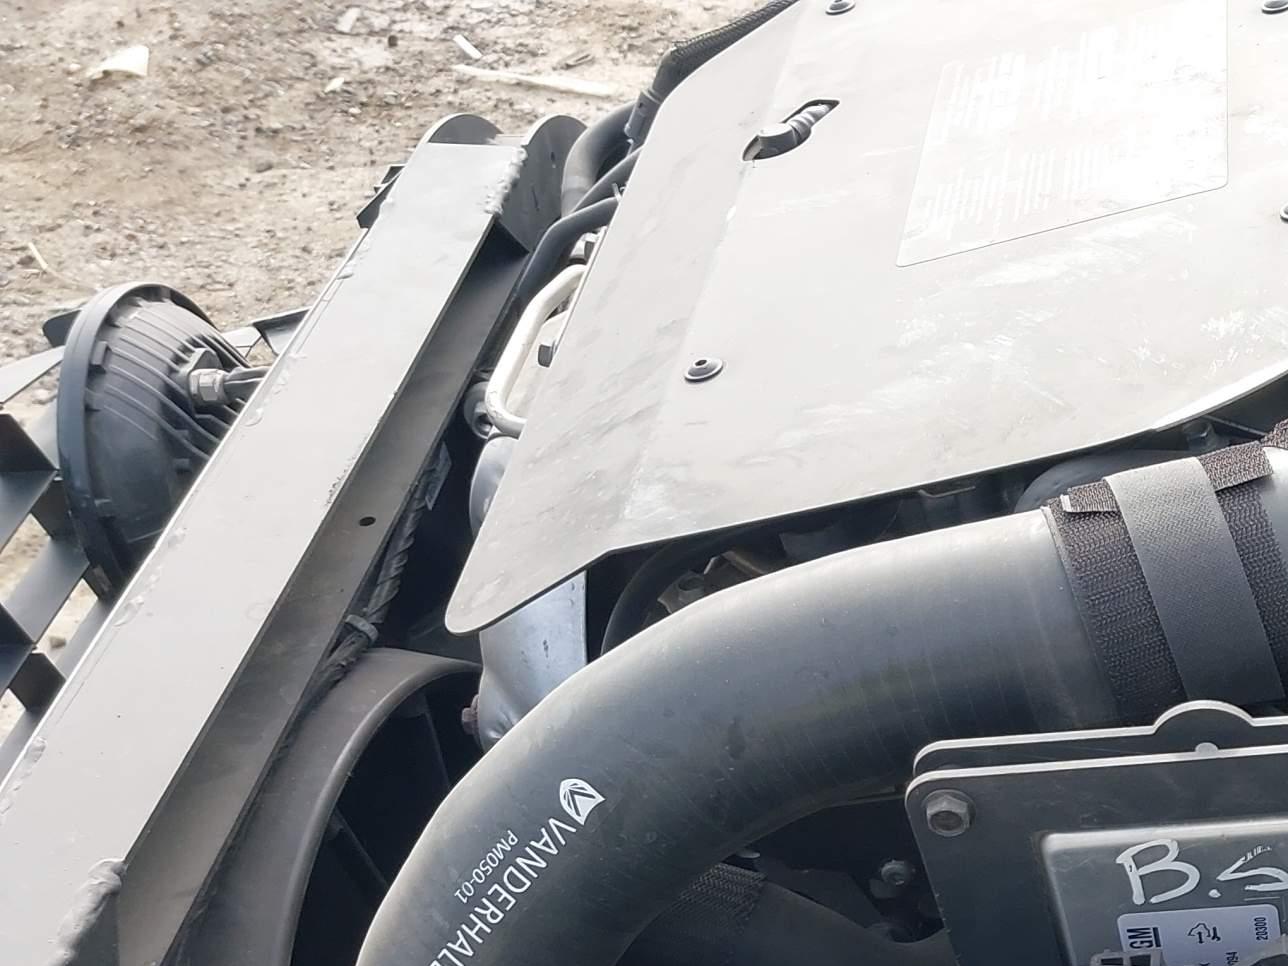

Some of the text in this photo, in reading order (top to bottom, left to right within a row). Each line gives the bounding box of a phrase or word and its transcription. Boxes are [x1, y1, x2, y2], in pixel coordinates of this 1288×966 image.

[454, 830, 519, 904] PM050-01
[1126, 926, 1158, 950] GM
[1254, 916, 1268, 941] 20300
